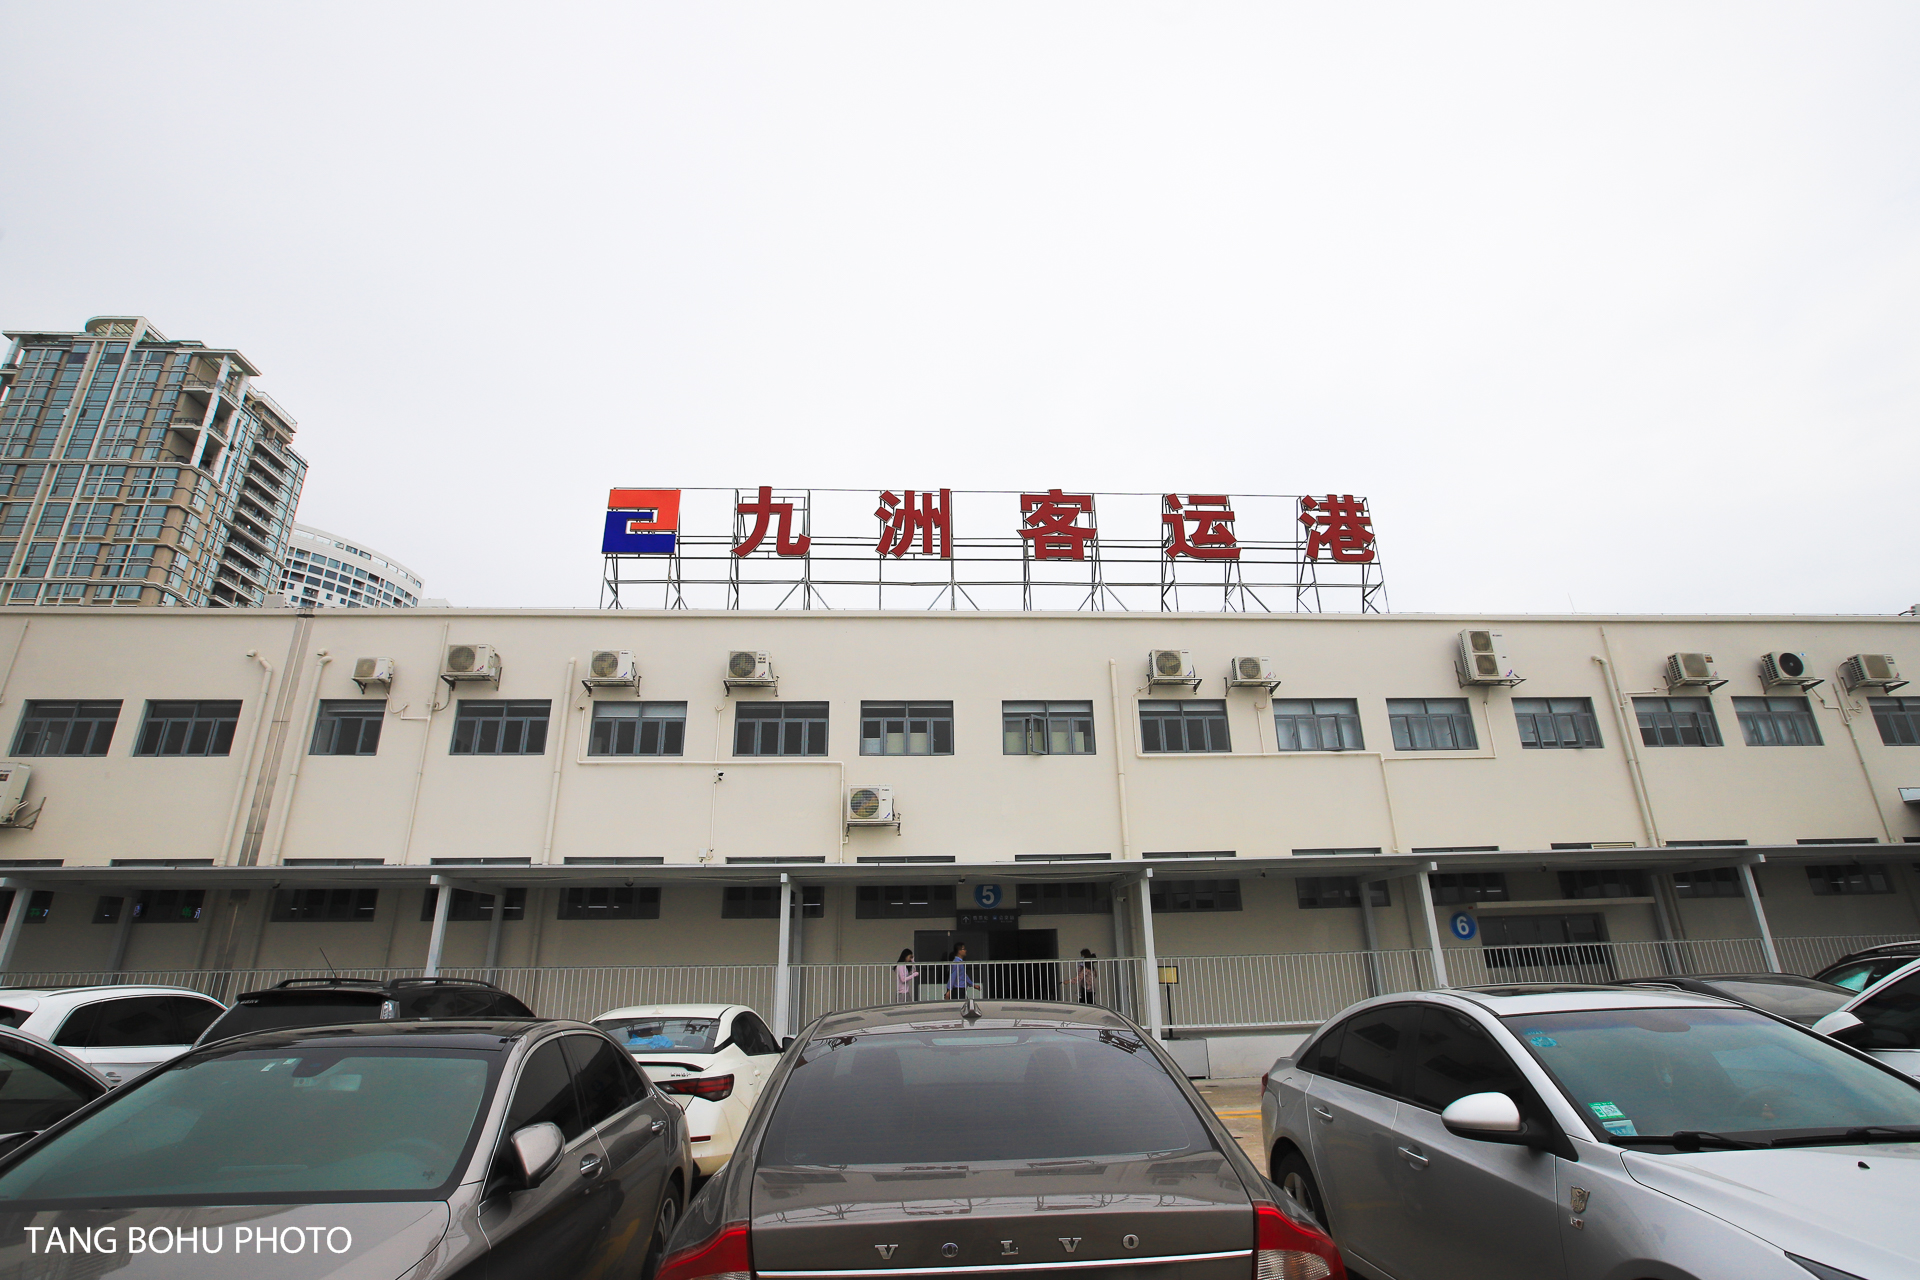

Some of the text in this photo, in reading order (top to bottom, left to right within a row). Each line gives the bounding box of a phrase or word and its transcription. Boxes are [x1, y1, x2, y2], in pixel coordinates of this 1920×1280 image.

[730, 486, 1376, 564] 九洲客运港
[982, 885, 995, 905] 5
[1457, 916, 1470, 935] 6
[875, 1234, 1140, 1260] VOLVO
